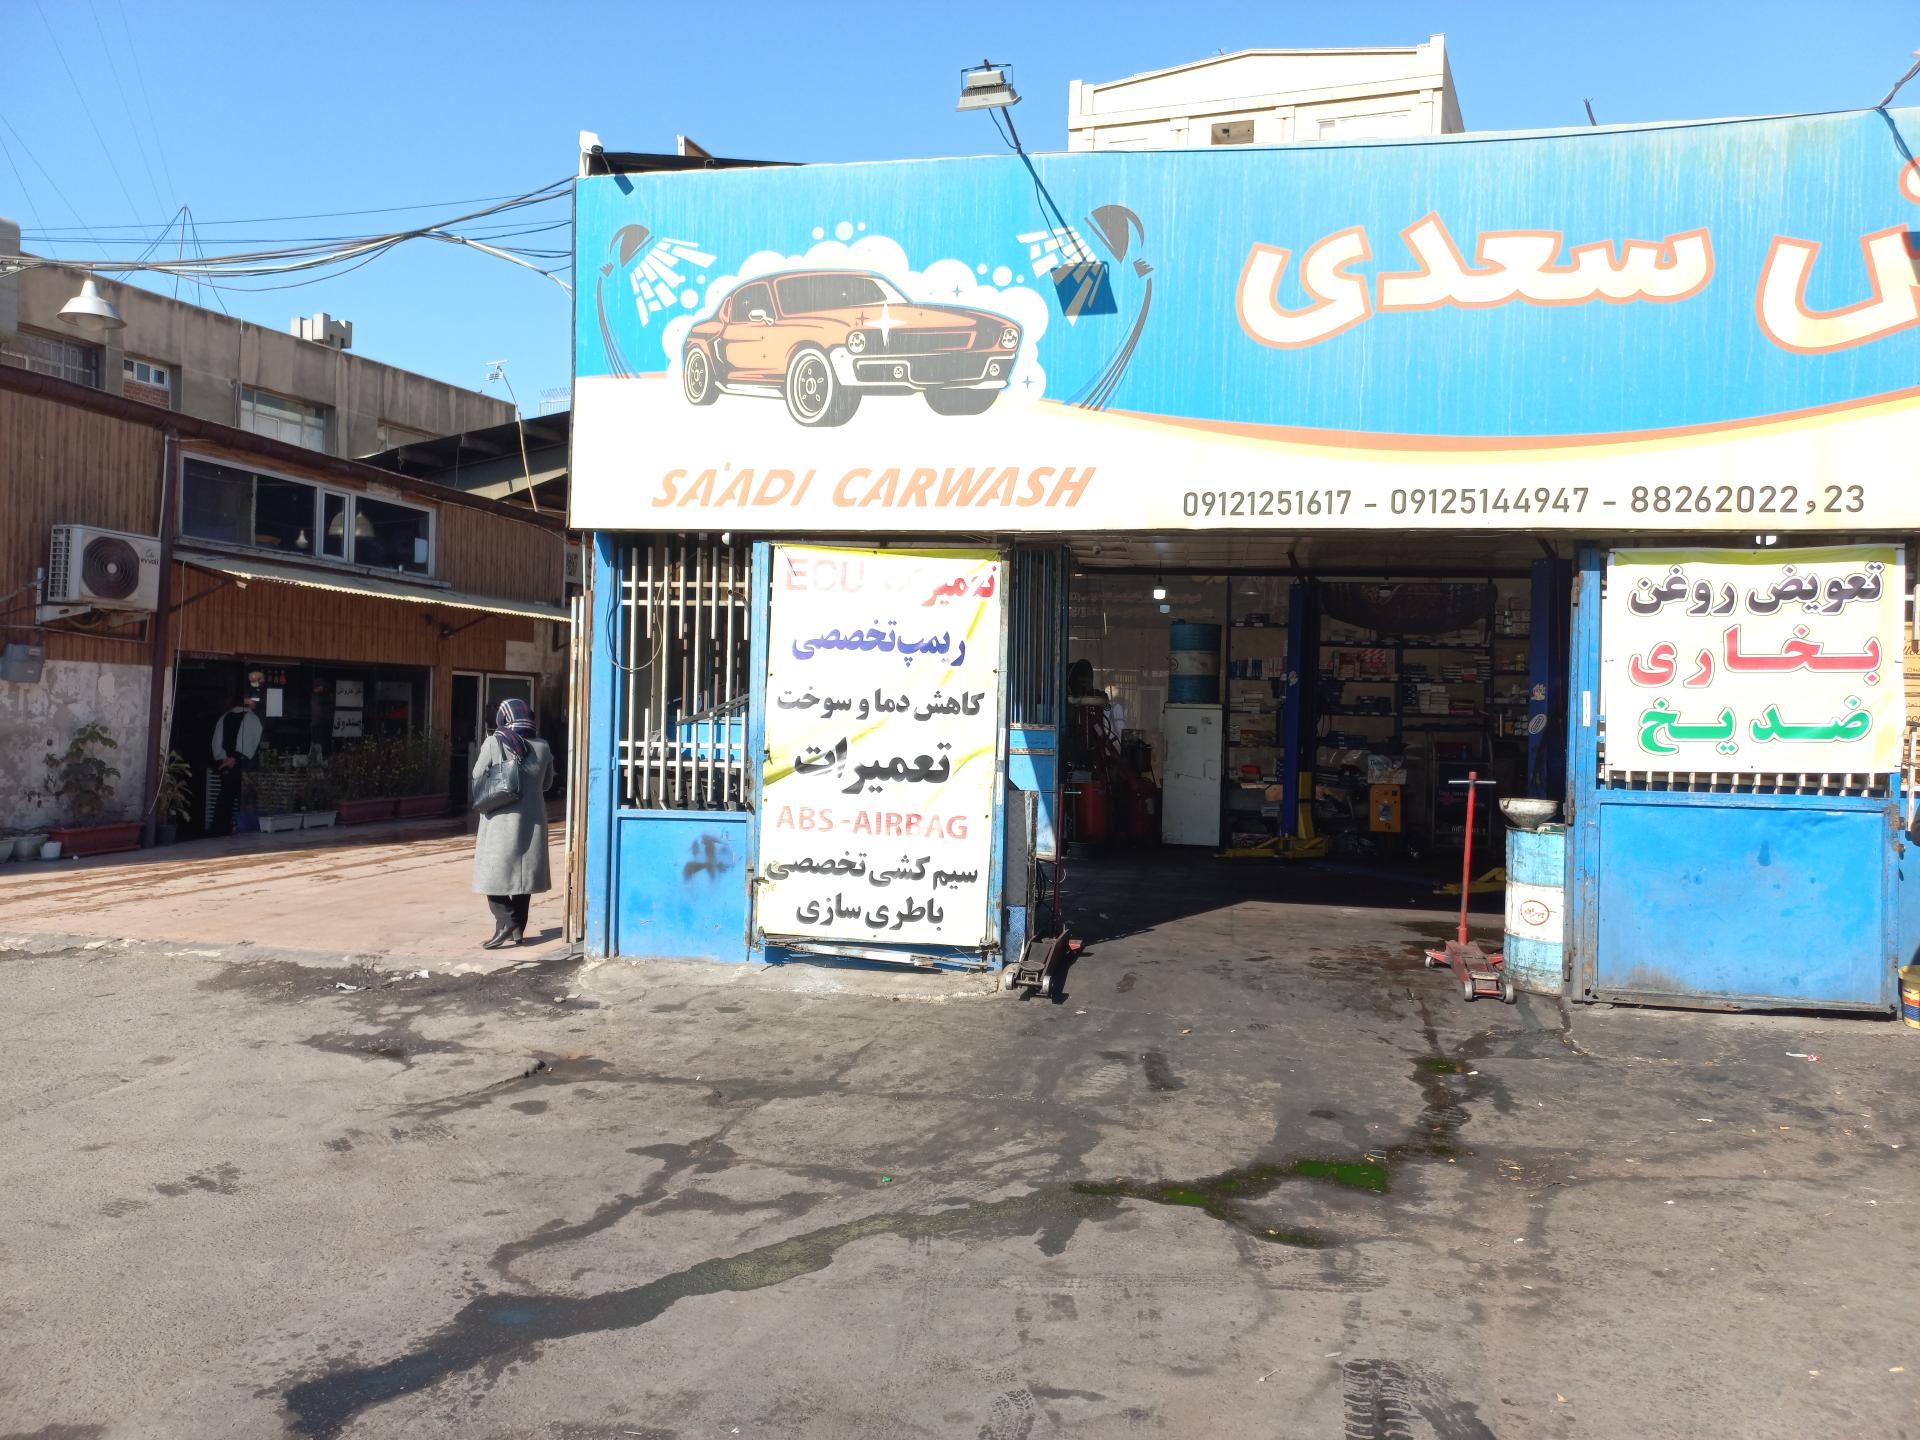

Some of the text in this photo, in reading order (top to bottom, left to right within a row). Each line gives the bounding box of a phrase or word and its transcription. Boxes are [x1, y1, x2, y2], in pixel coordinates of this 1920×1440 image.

[1235, 211, 1715, 350] سعدی
[831, 466, 1097, 508] CARWASH
[1182, 490, 1352, 517] 09121251617
[1389, 487, 1590, 515] 09125144947
[1628, 560, 1885, 616] تعویض روغن
[792, 619, 965, 667] ریمپ تخصصی
[1629, 624, 1883, 689] بخاری
[777, 686, 986, 721] کاهش دما و سوخت
[1638, 695, 1874, 756] ضد یخ
[795, 737, 952, 795] تعمیرات
[766, 851, 978, 890] سیم کشی تخصصی
[796, 893, 944, 931] باطری سازی
